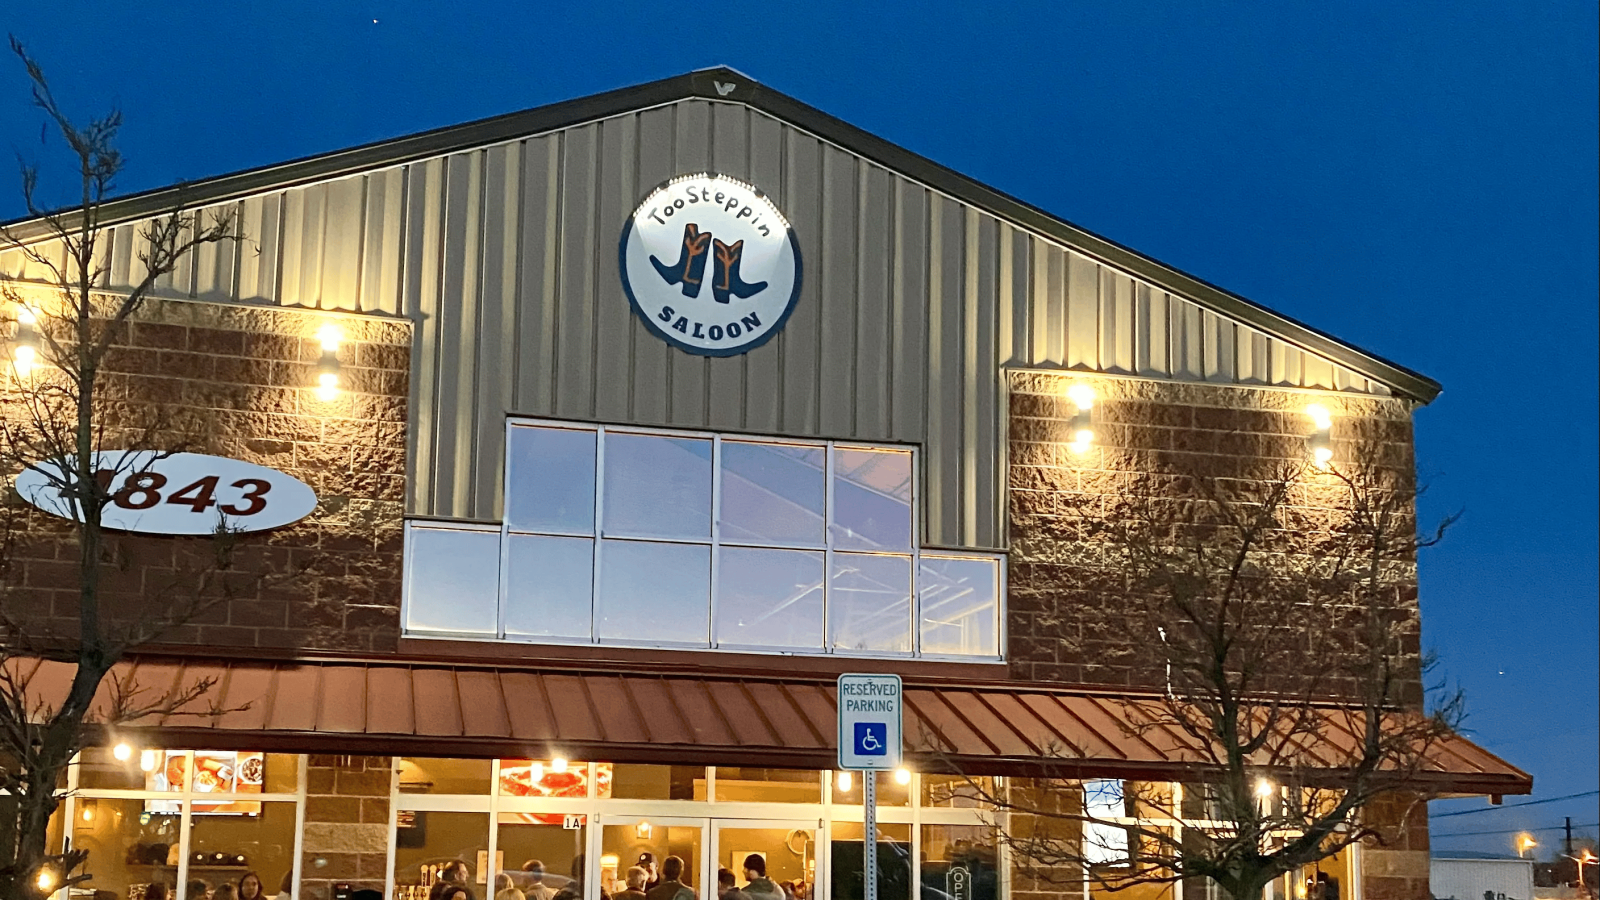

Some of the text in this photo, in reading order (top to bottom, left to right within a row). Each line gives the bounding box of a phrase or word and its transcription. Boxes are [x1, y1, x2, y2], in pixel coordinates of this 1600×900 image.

[647, 186, 770, 237] TooSteppin
[657, 305, 762, 341] SALOON
[843, 683, 897, 696] RESERVED
[846, 699, 894, 712] PARKING
